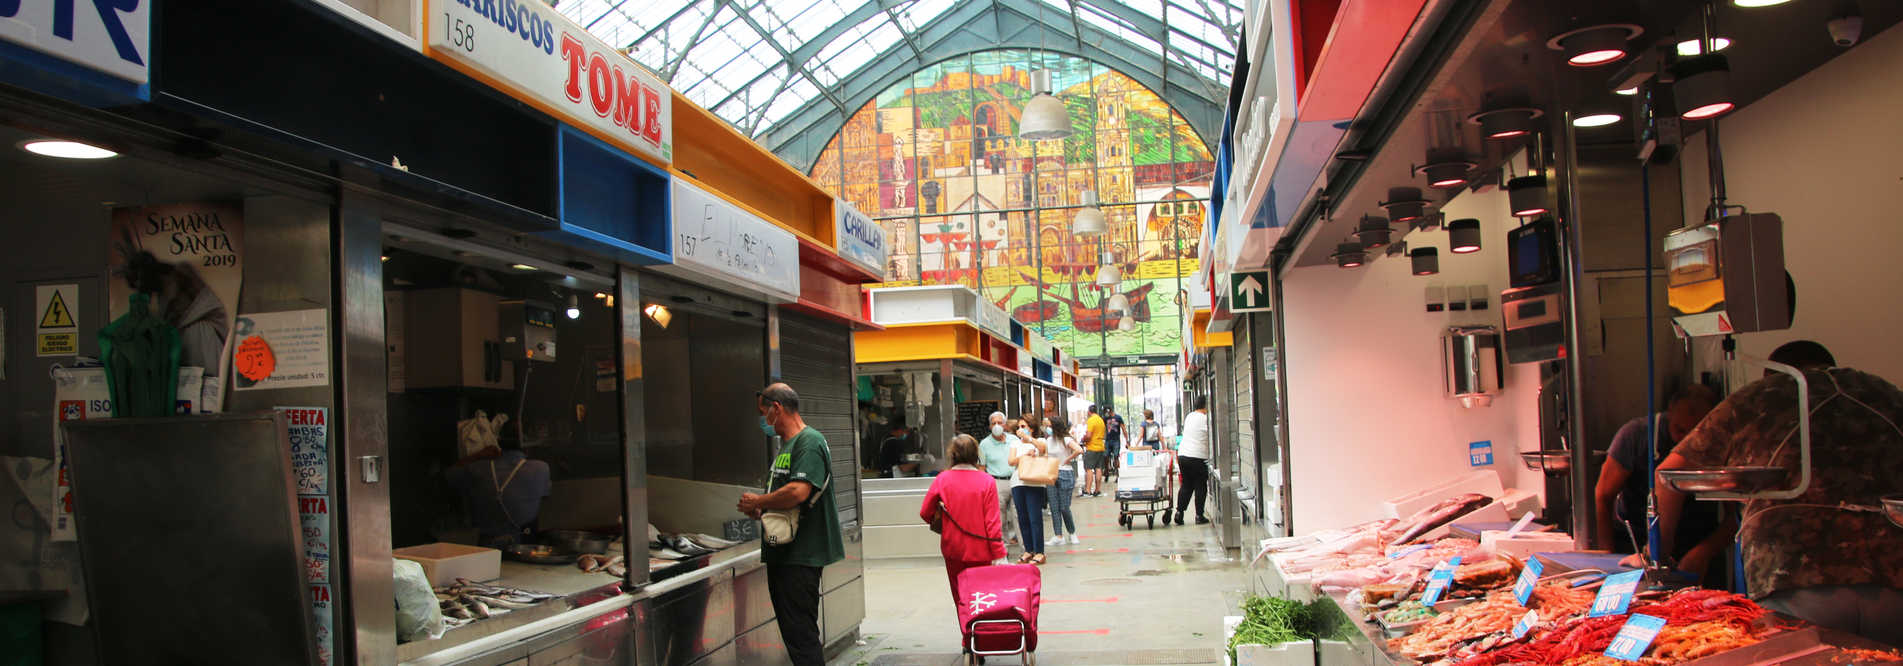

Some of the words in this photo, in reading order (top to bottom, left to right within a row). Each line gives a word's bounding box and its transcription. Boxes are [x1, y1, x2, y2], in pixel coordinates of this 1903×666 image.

[444, 12, 474, 52] 158
[455, 0, 554, 56] ARISCOS
[560, 31, 664, 148] TOME
[146, 210, 225, 236] SEMANA
[170, 232, 235, 255] SANTA
[679, 233, 697, 257] 157
[203, 254, 237, 267] 2019
[298, 498, 328, 514] RTA
